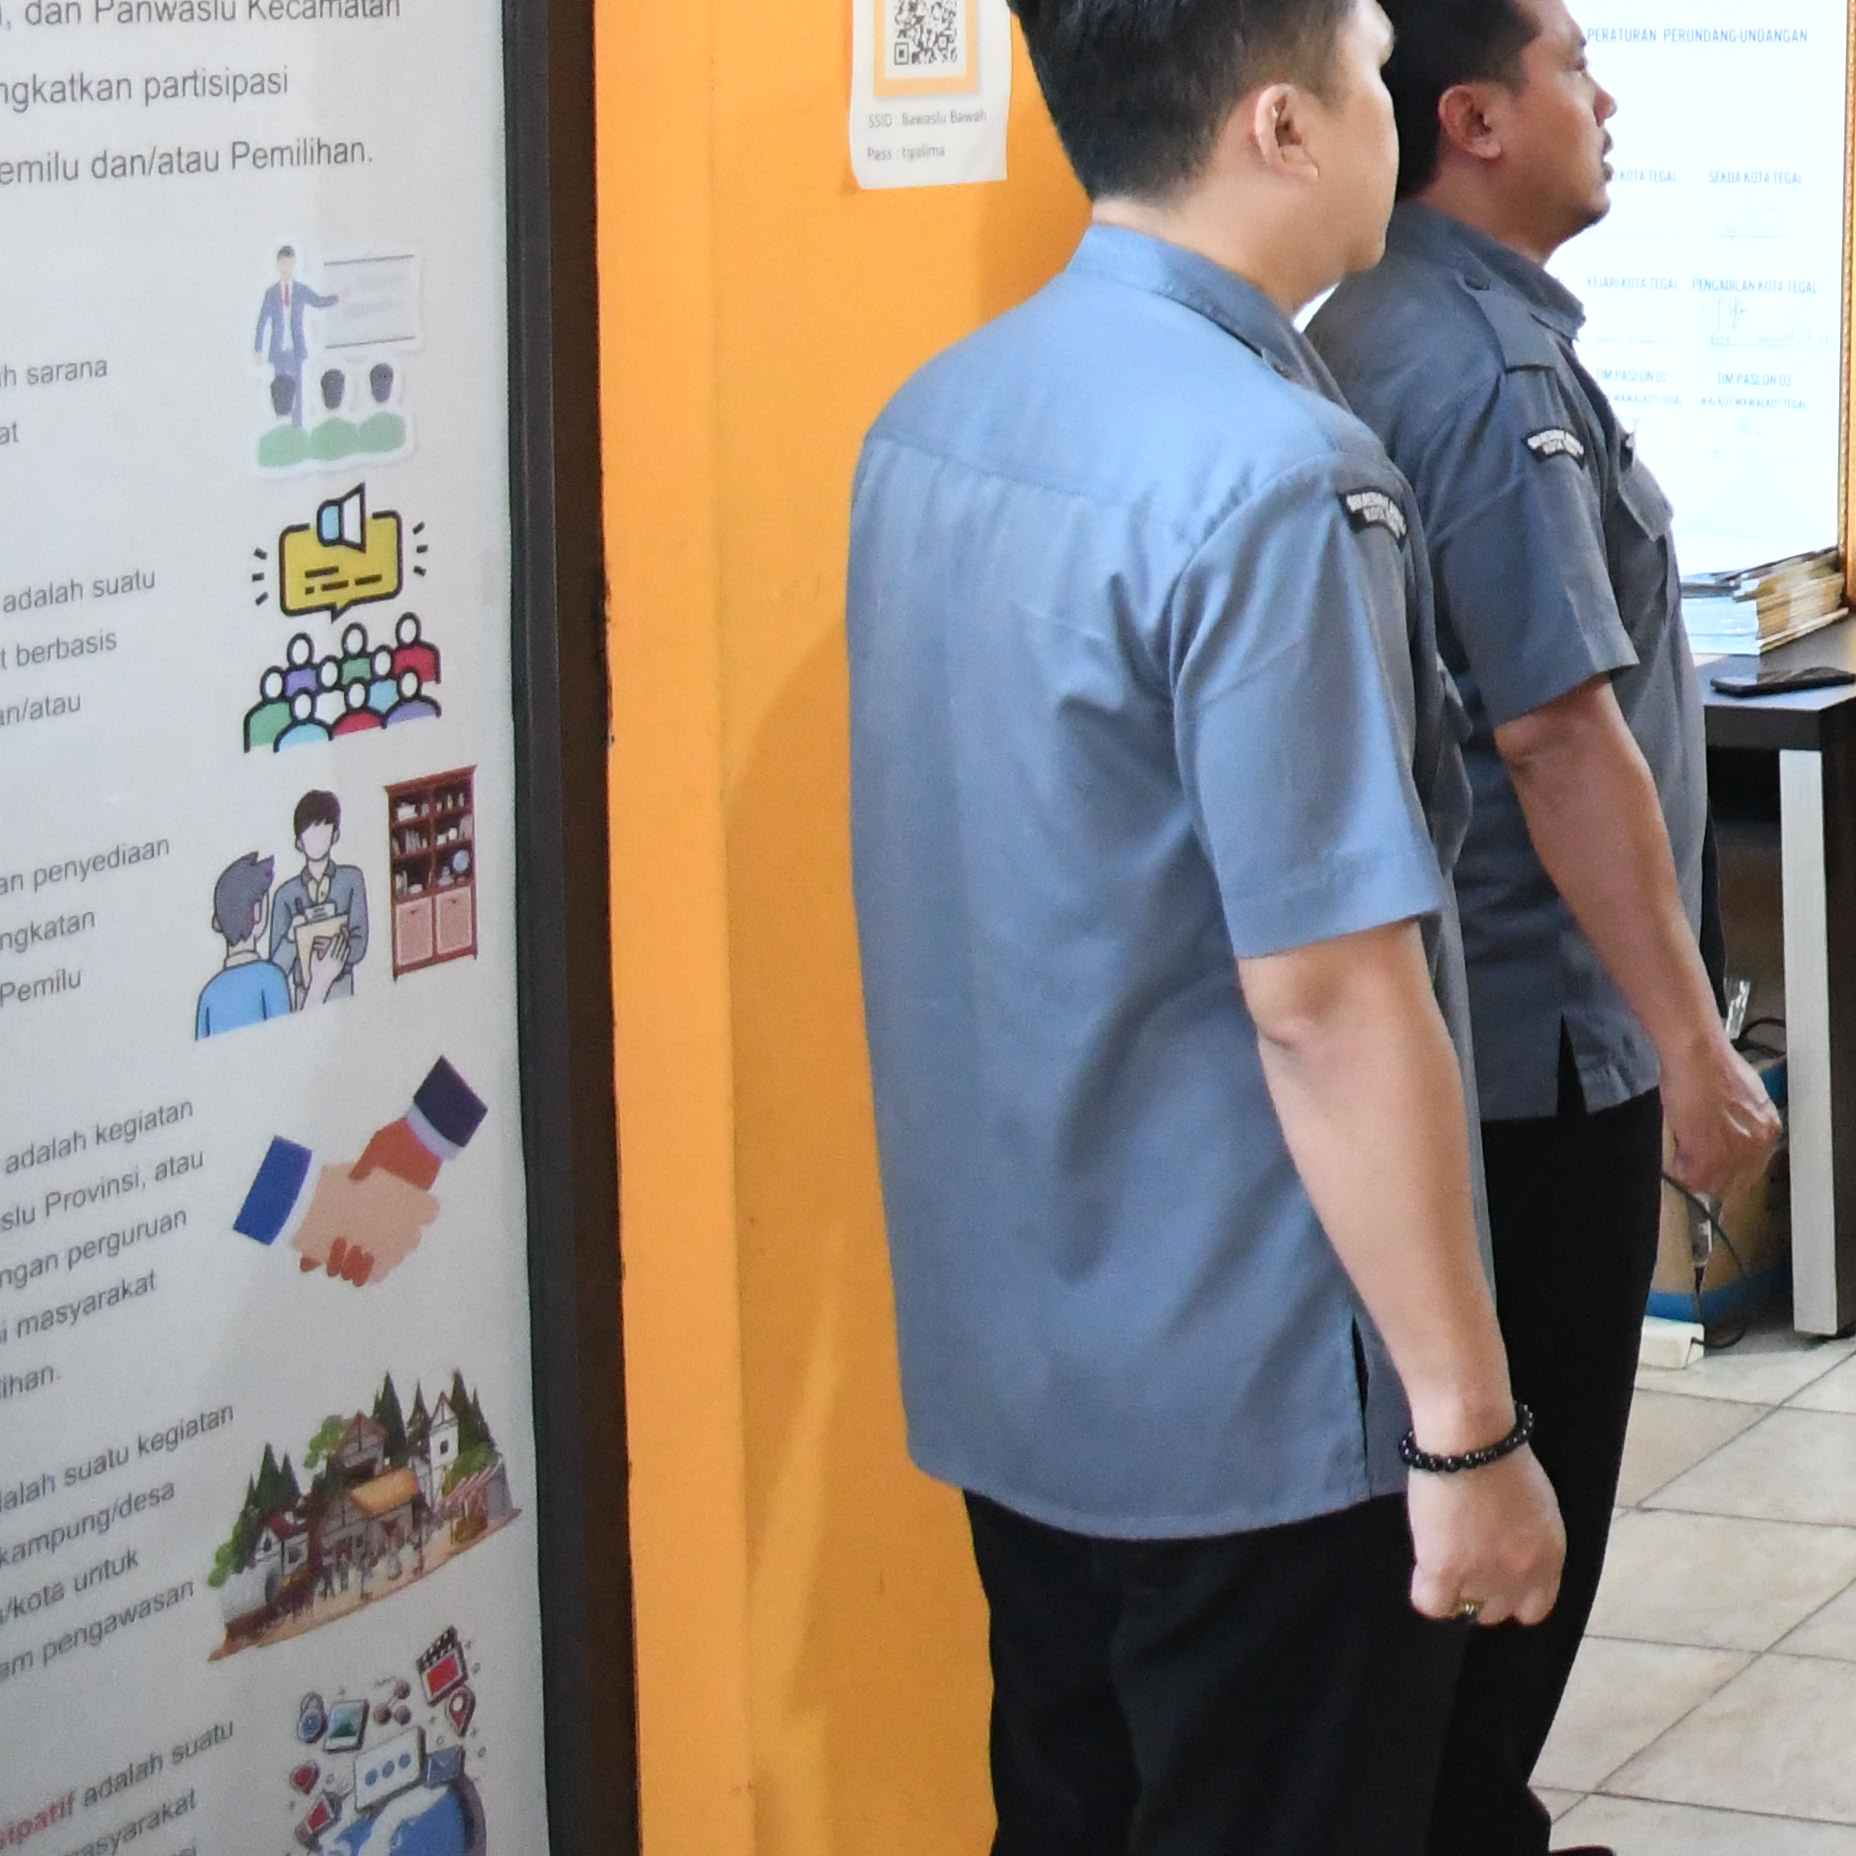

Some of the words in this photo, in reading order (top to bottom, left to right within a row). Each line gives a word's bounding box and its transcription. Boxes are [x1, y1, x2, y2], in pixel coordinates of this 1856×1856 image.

[144, 64, 289, 107] partisipasi
[90, 145, 220, 180] dan/atau
[231, 136, 374, 171] Pemilihan.
[26, 358, 108, 386] sarana
[2, 576, 84, 614] adalah
[91, 569, 157, 600] suatu
[15, 626, 118, 668] berbasis
[33, 837, 171, 894] penyediaan
[5, 1129, 88, 1175] adalah
[96, 1100, 194, 1146] kegiatan
[45, 1164, 147, 1219] Provinsi,
[154, 1151, 205, 1184] atau
[67, 1209, 188, 1273] perguruan
[17, 1268, 157, 1340] masyarakat
[0, 1472, 57, 1512] alah
[64, 1445, 130, 1487] suatu
[137, 1404, 235, 1459] kegiatan
[74, 1547, 139, 1593] untuk
[42, 1580, 195, 1668] pengawasan
[0, 1789, 76, 1851] ipatif
[82, 1750, 164, 1808] adalah
[170, 1719, 234, 1766] suatu
